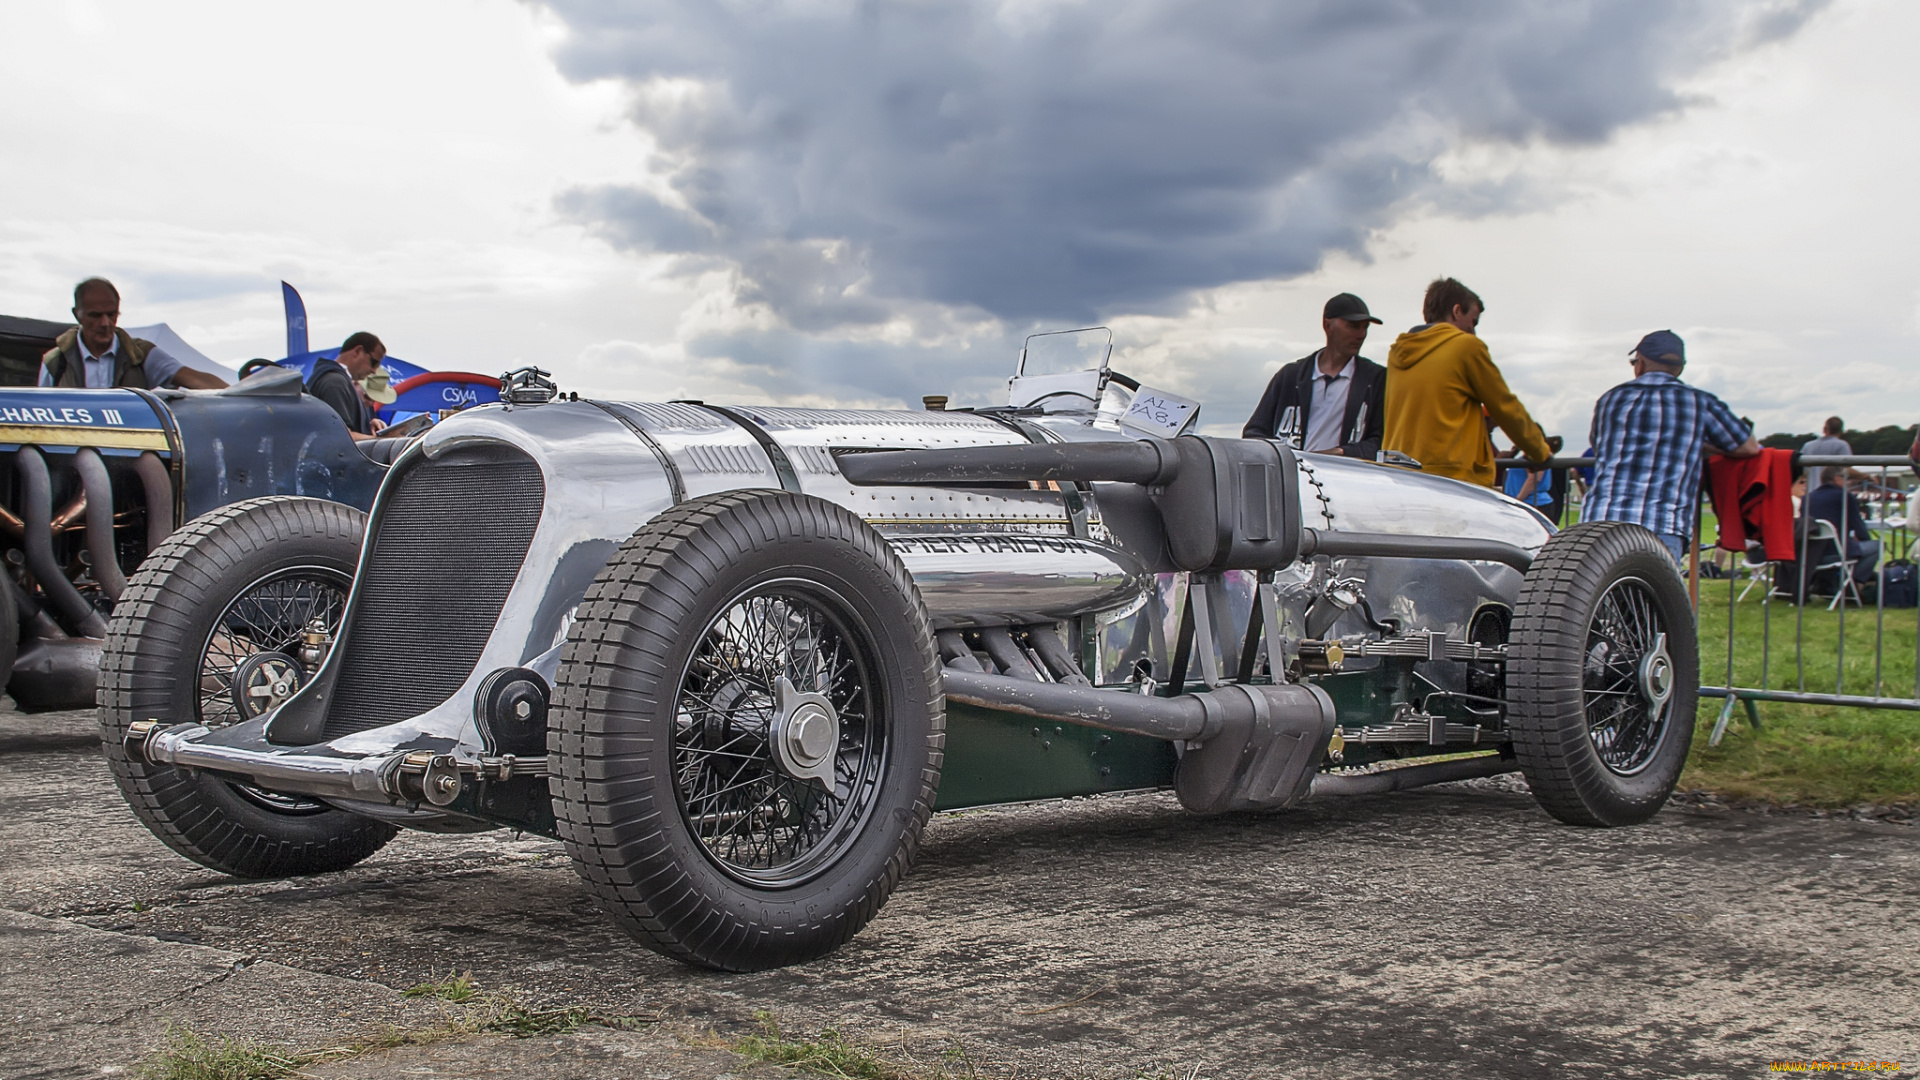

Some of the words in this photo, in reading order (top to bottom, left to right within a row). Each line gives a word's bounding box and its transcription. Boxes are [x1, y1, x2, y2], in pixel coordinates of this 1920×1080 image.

[442, 387, 478, 403] CSMA
[101, 409, 124, 425] III
[884, 536, 1088, 554] APIER-RAILTON
